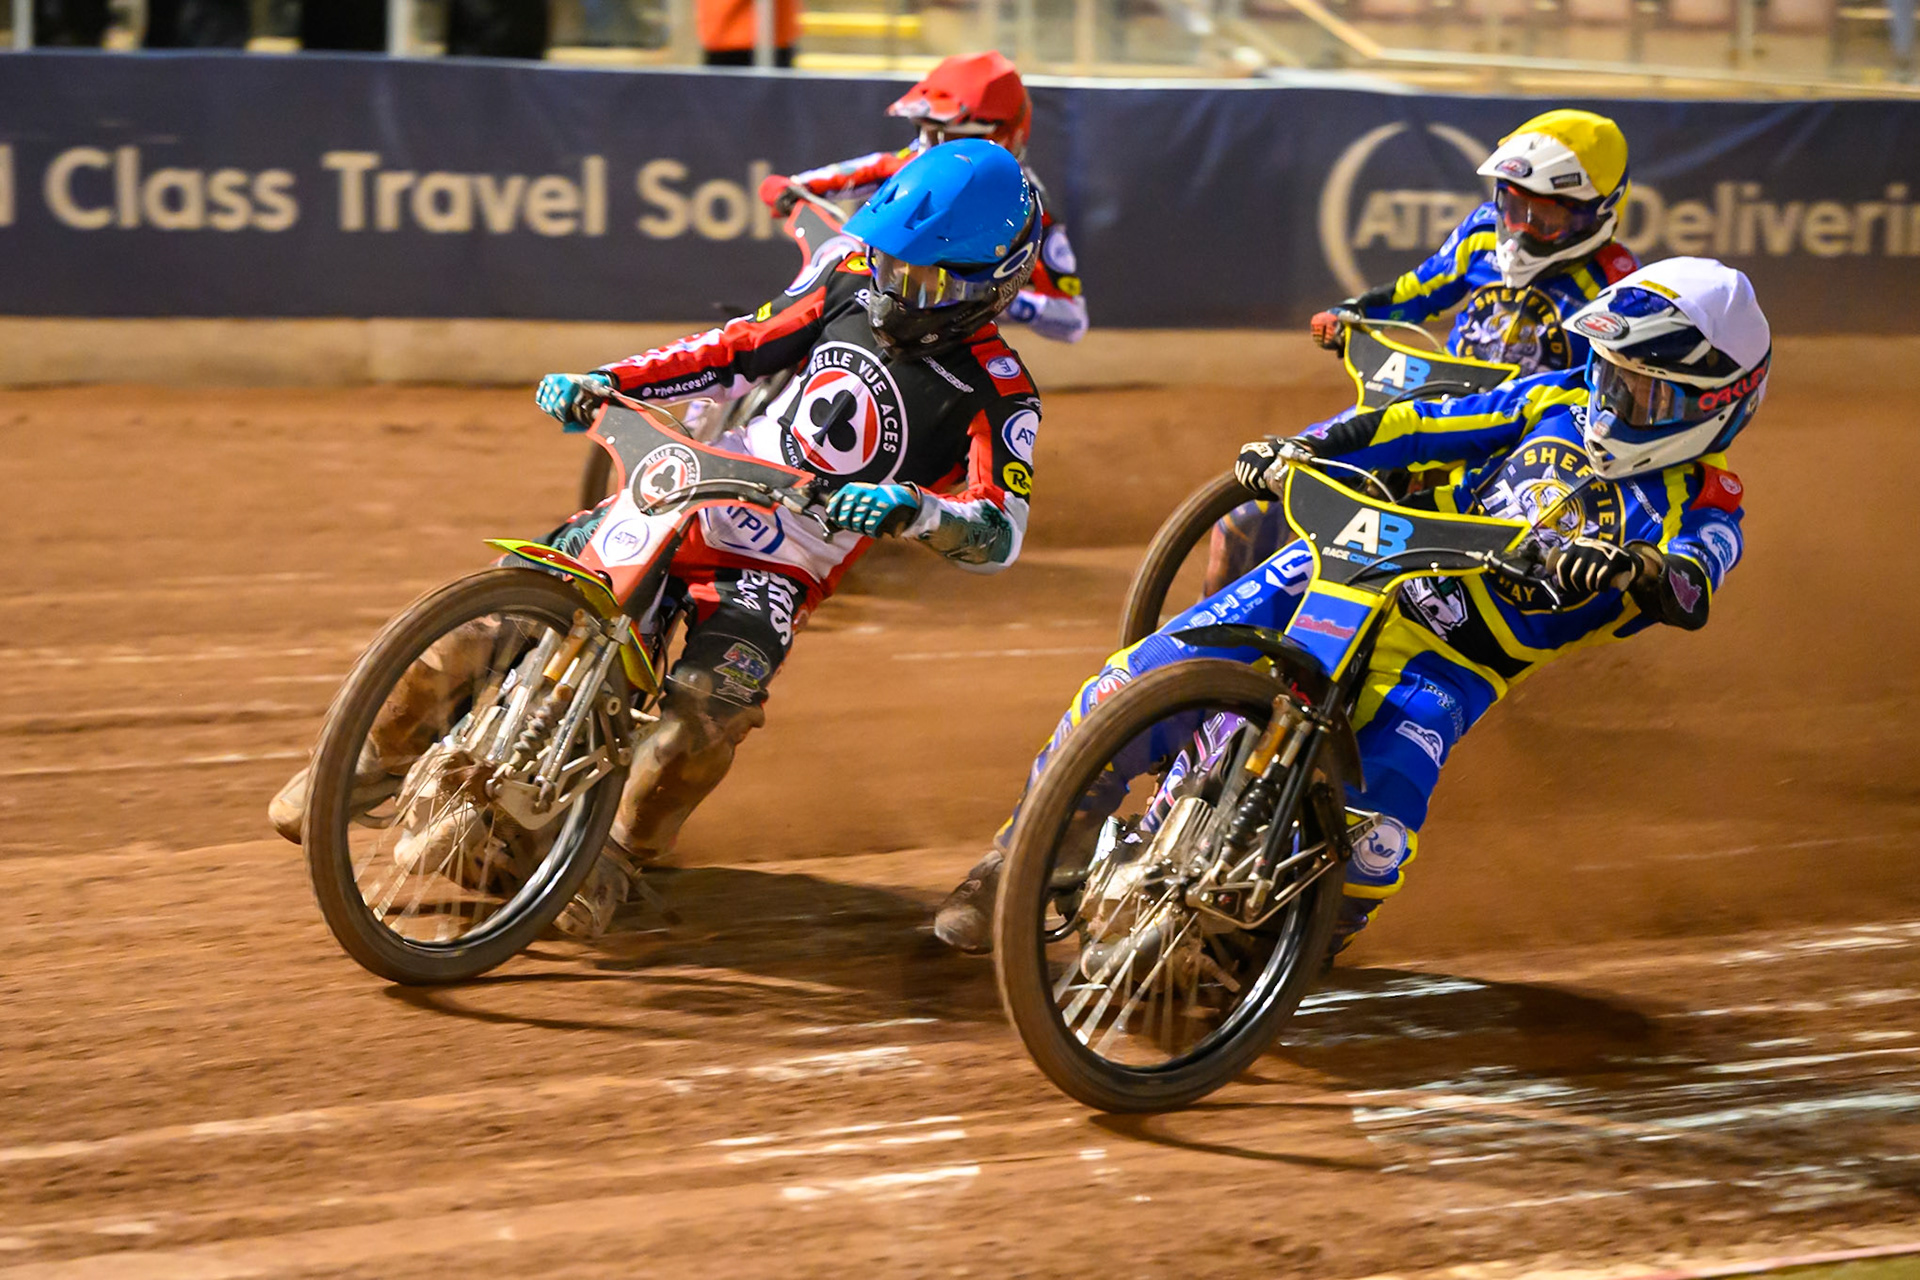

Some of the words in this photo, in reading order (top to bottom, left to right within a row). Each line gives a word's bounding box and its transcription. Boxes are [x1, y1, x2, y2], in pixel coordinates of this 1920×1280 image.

[45, 146, 299, 231] Class
[322, 150, 607, 236] Travel
[637, 159, 790, 240] Sol
[1354, 189, 1482, 250] ATP
[1617, 181, 1920, 257] Deliveri
[1373, 351, 1431, 390] AB
[858, 360, 887, 396] VUE
[880, 403, 898, 454] ACES
[1016, 427, 1036, 446] AT
[1523, 447, 1616, 546] SHEFFIEL
[1322, 546, 1350, 560] RACE
[1333, 507, 1414, 557] AB
